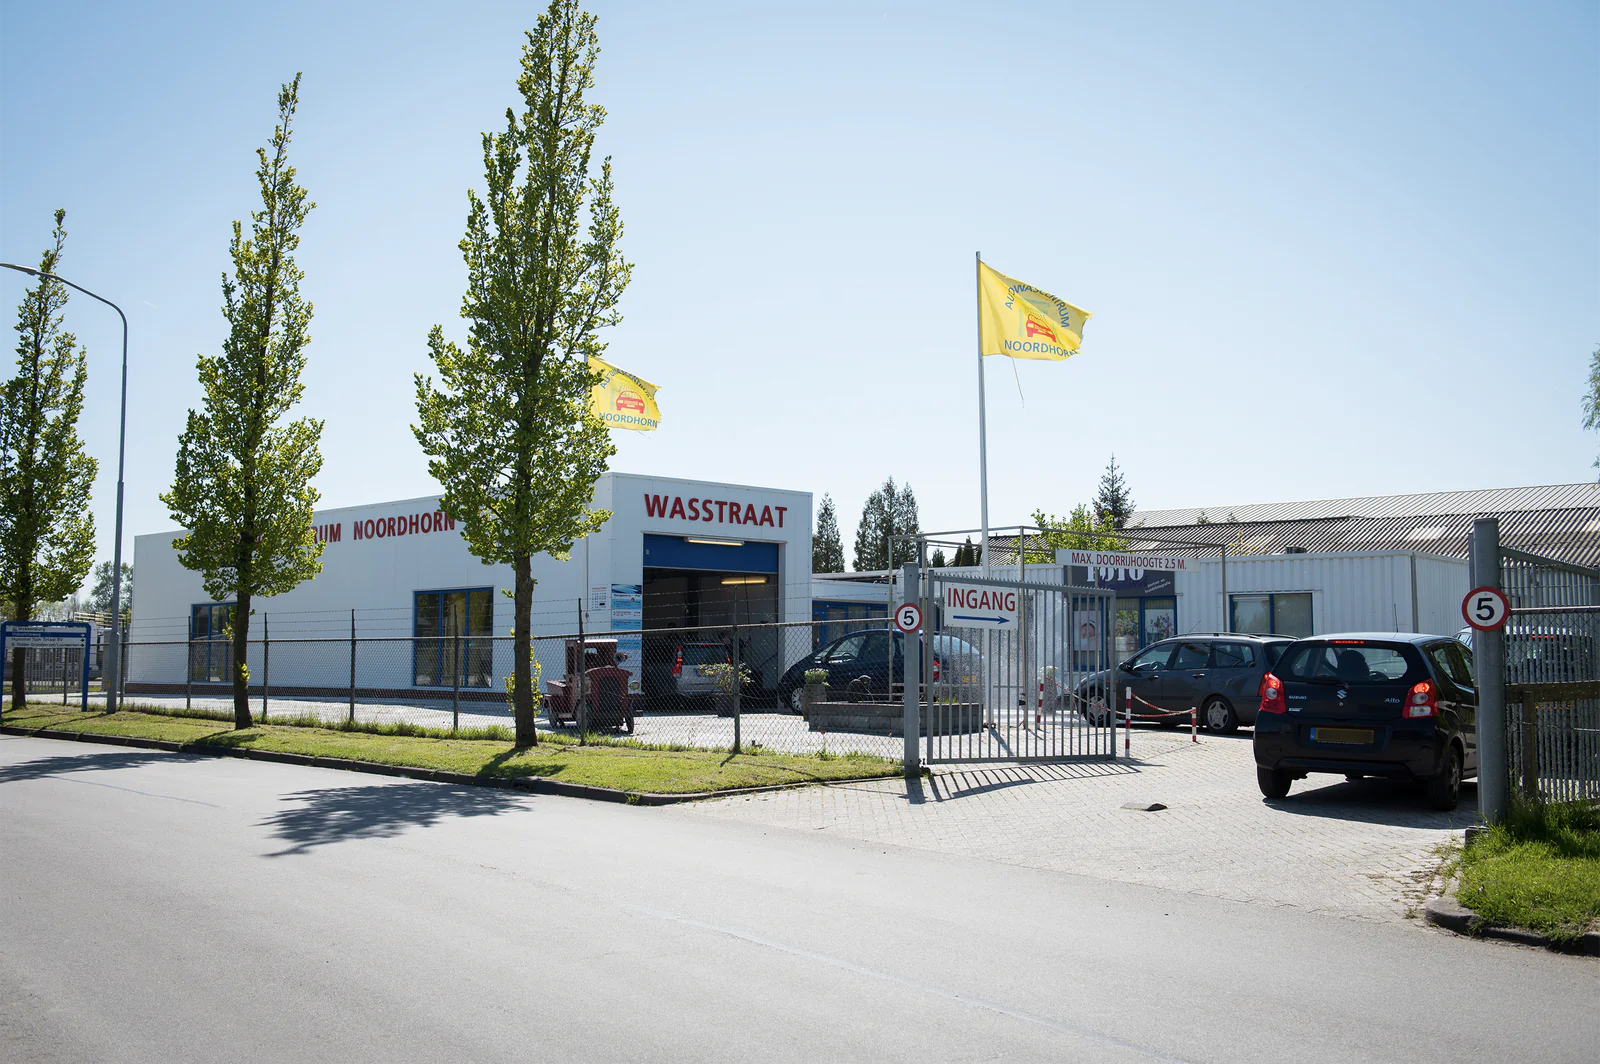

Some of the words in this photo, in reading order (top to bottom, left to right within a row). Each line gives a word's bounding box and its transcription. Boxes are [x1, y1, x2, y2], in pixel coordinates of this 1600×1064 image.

[599, 412, 658, 428] NOORDHORN
[644, 493, 788, 528] WASSTRAAT
[353, 511, 456, 541] NOORDHORN
[1071, 552, 1094, 566] MAX.
[1096, 553, 1163, 569] DOORRIJHOOGTE
[1164, 558, 1176, 569] 2.5
[1177, 558, 1187, 570] M.
[947, 587, 1016, 612] INGANG
[1475, 597, 1495, 621] 5
[903, 610, 915, 626] 5
[1384, 696, 1401, 704] Alto
